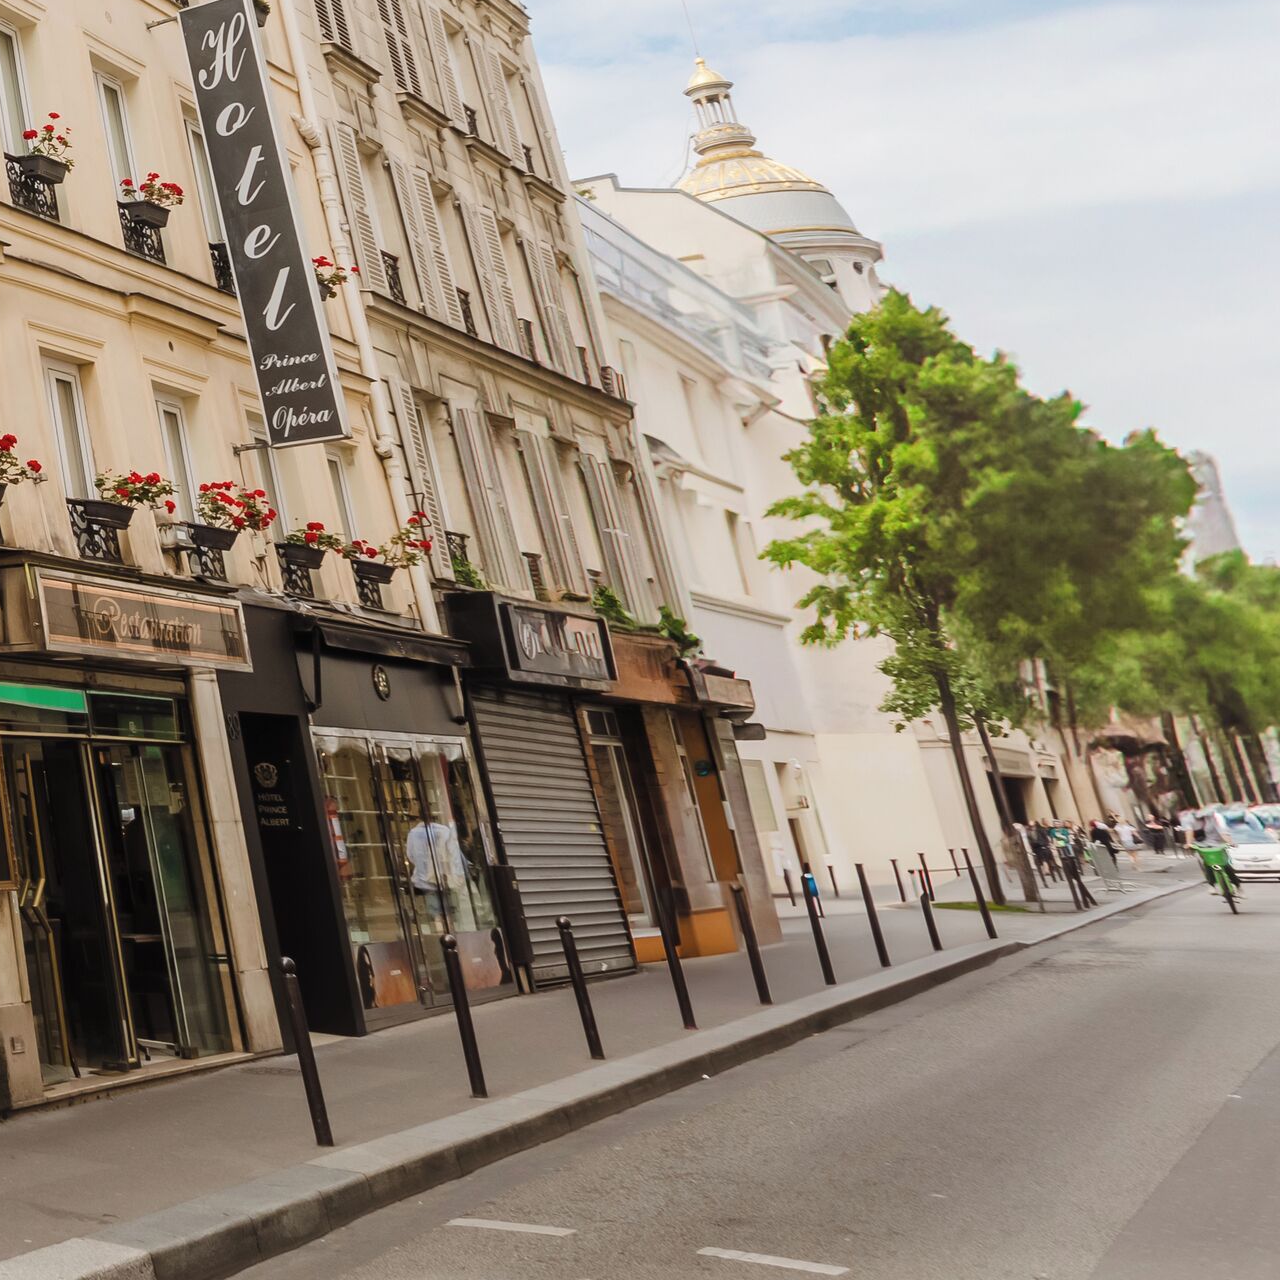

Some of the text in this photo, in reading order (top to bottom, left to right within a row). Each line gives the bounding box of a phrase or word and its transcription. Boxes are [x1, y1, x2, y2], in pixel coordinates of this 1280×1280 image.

[198, 12, 296, 332] Hotel
[260, 352, 320, 371] Prince
[265, 376, 327, 397] Albert
[271, 404, 333, 438] Opéra
[258, 805, 288, 814] PRINCE
[260, 818, 289, 826] ALBERT
